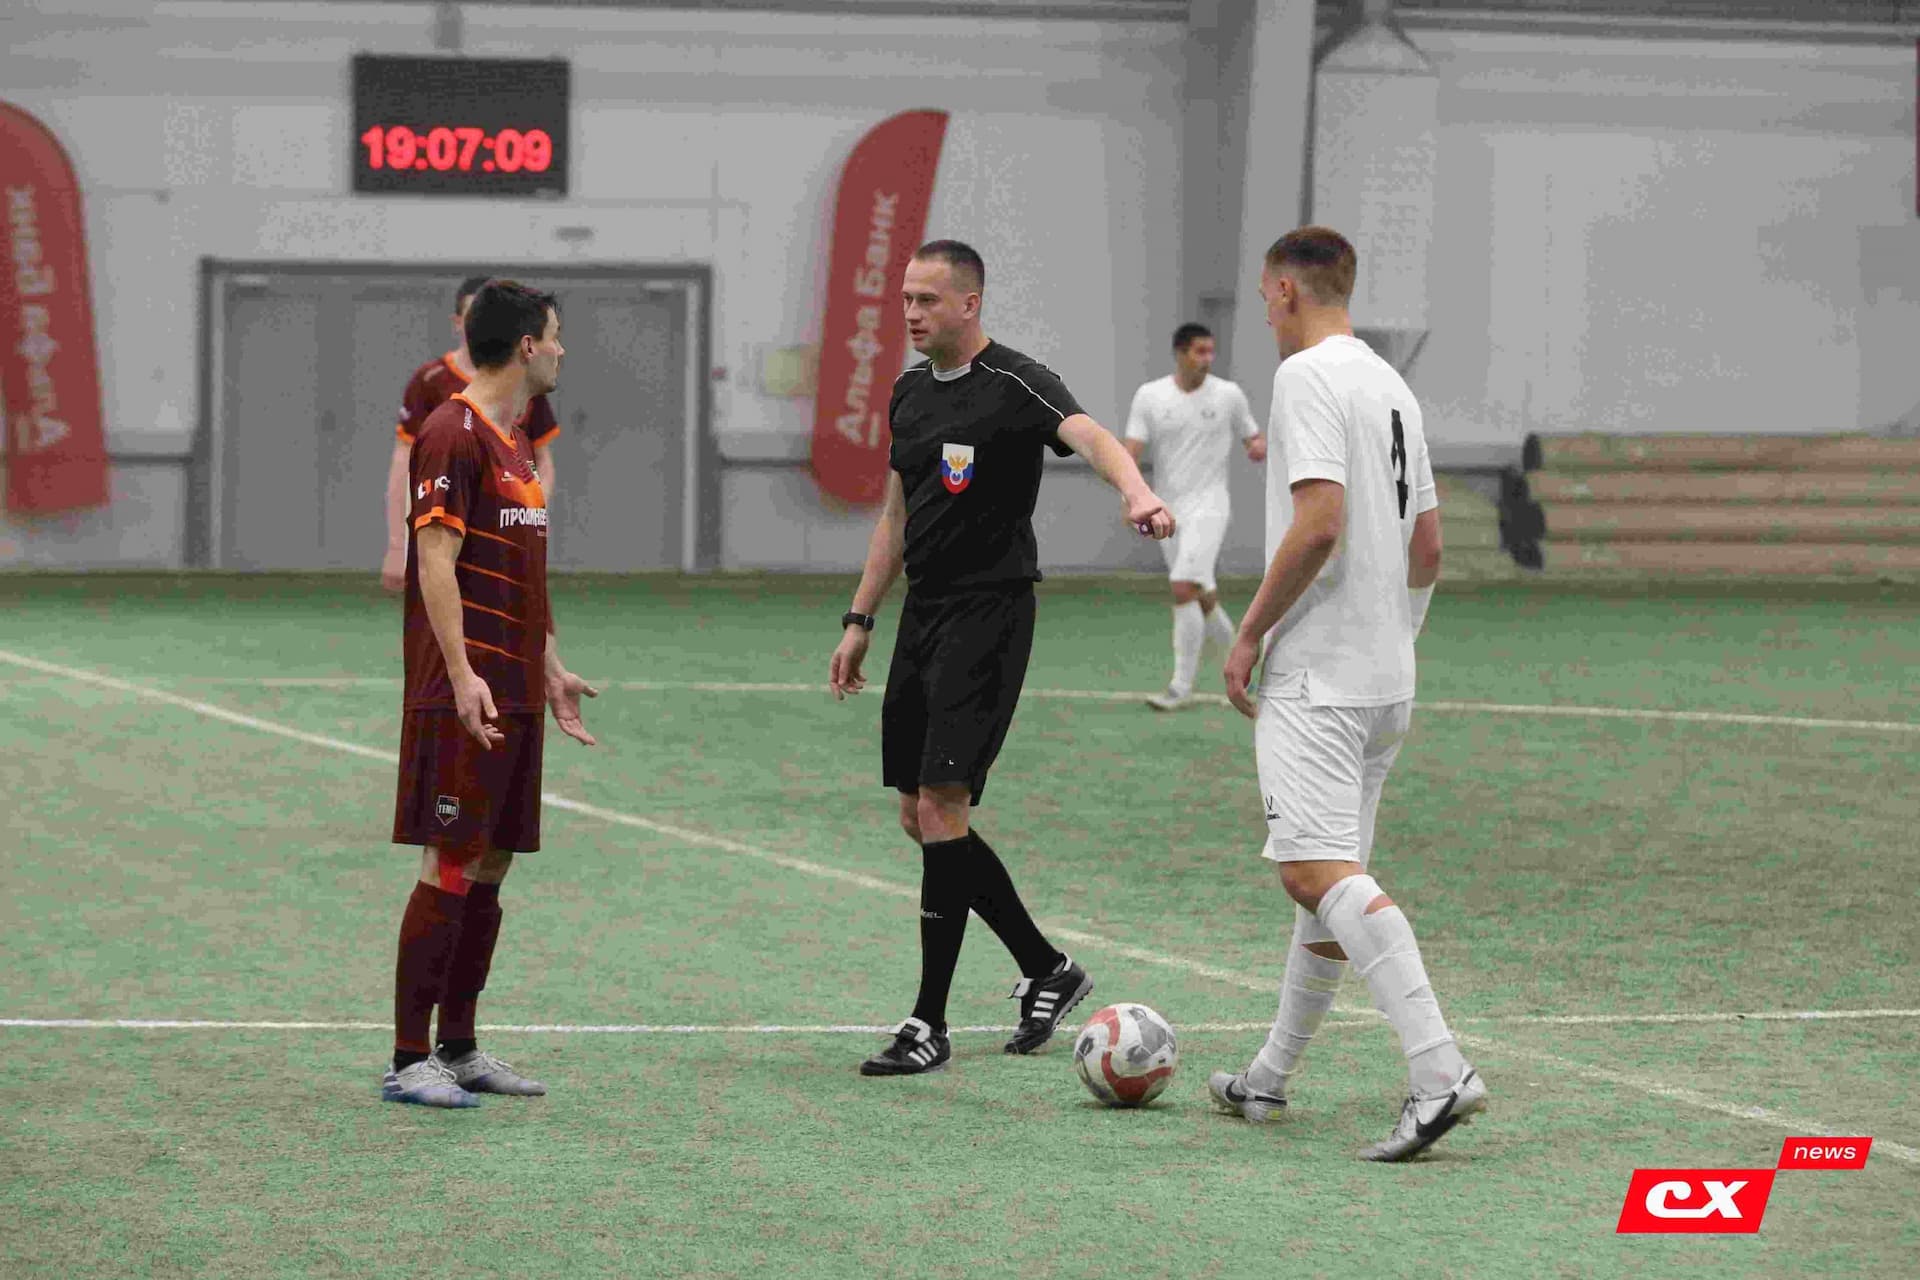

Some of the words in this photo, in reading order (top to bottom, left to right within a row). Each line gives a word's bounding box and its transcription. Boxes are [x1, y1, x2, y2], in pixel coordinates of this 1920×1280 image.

[361, 124, 552, 173] 19:07:09
[854, 189, 899, 296] Банк
[836, 305, 883, 445] Альфа
[1389, 408, 1409, 520] 4
